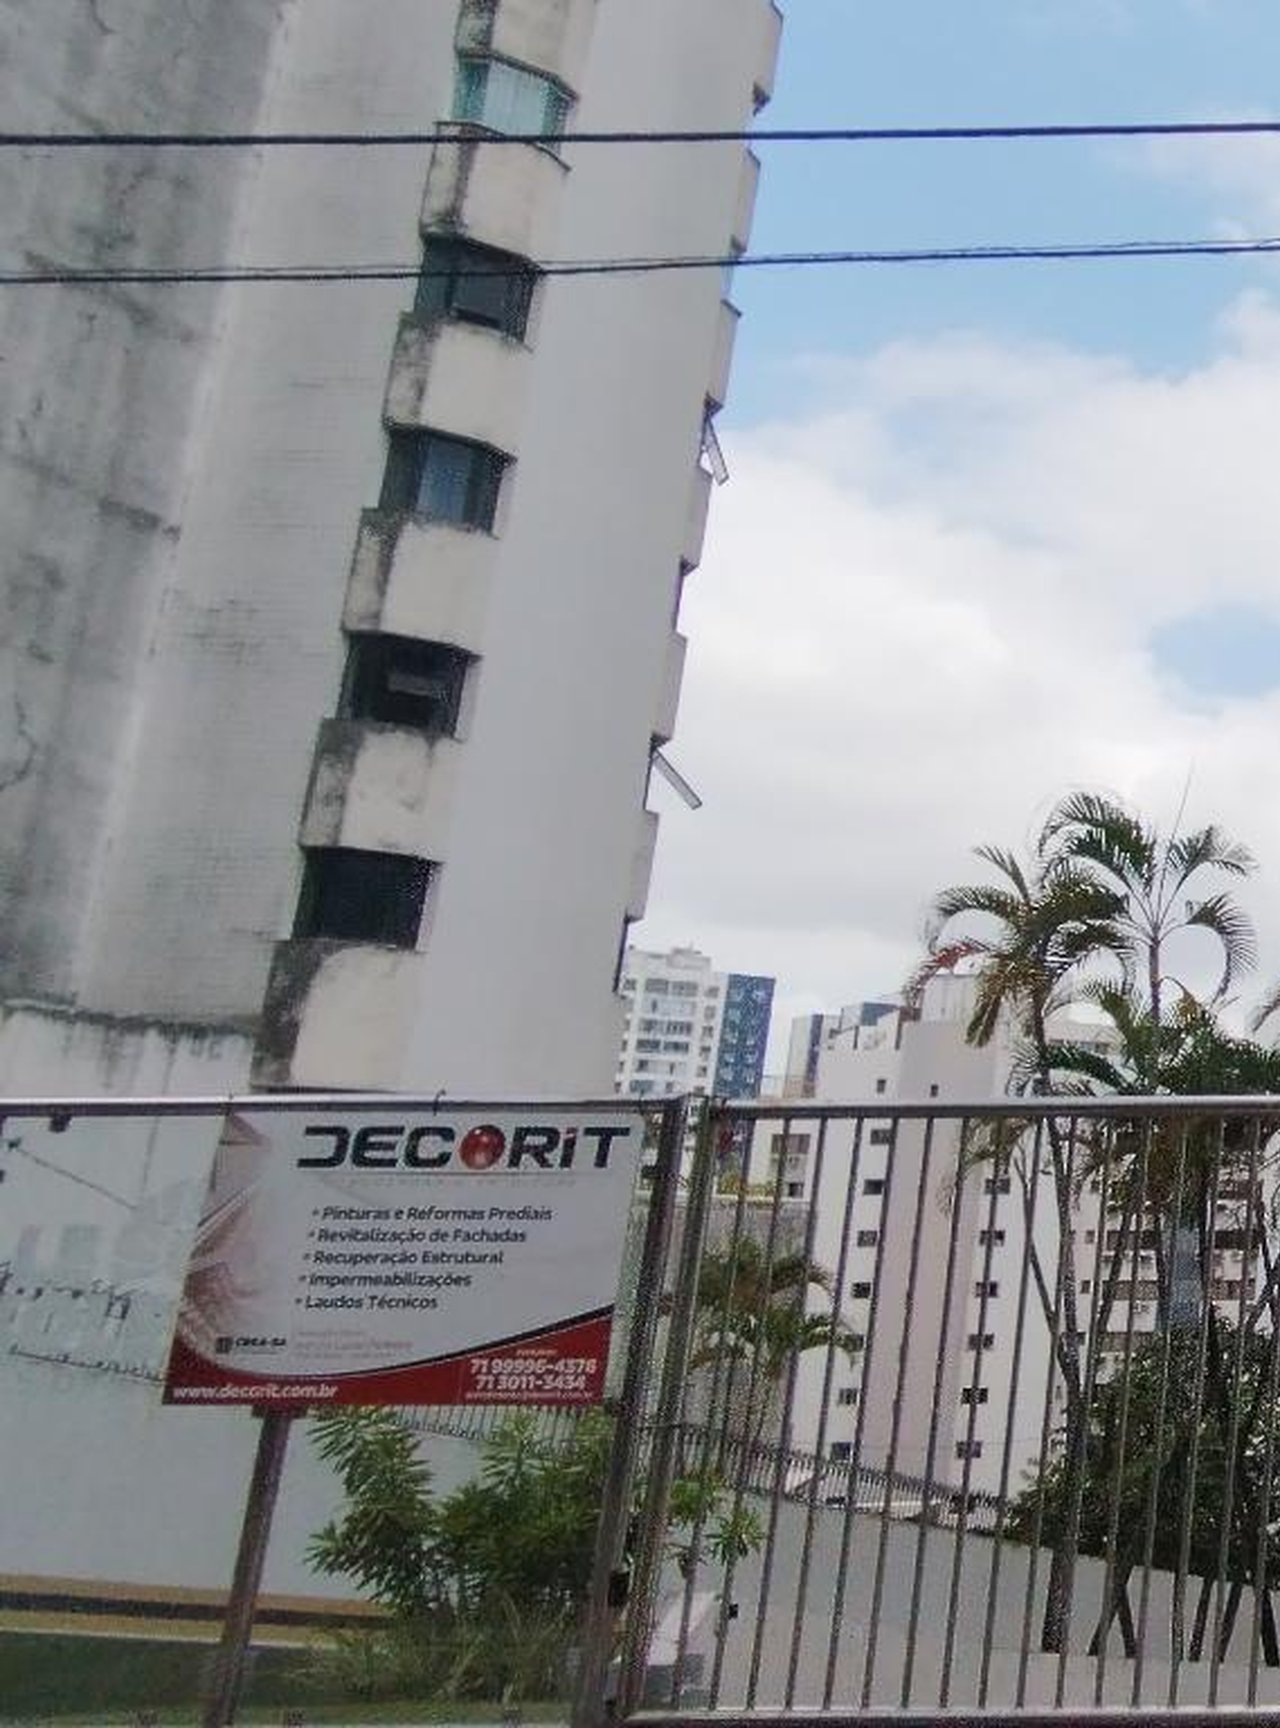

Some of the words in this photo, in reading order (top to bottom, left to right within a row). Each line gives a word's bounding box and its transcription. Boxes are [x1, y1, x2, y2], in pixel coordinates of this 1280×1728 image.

[322, 1207, 391, 1220] Pinturas
[394, 1209, 404, 1220] e
[407, 1206, 485, 1220] Reformas
[488, 1206, 553, 1221] Prediais
[318, 1228, 426, 1246] Revitalização
[429, 1229, 449, 1243] de
[452, 1229, 527, 1243] Fachadas
[313, 1250, 418, 1266] Recuperação
[422, 1250, 504, 1264] Estrutural
[309, 1273, 472, 1289] Impermeabilizações
[305, 1295, 363, 1310] Laudos
[367, 1294, 438, 1310] Técnicos
[470, 1358, 488, 1374] 71
[476, 1375, 495, 1390] 71
[173, 1384, 339, 1399] www.decorit.com.br
